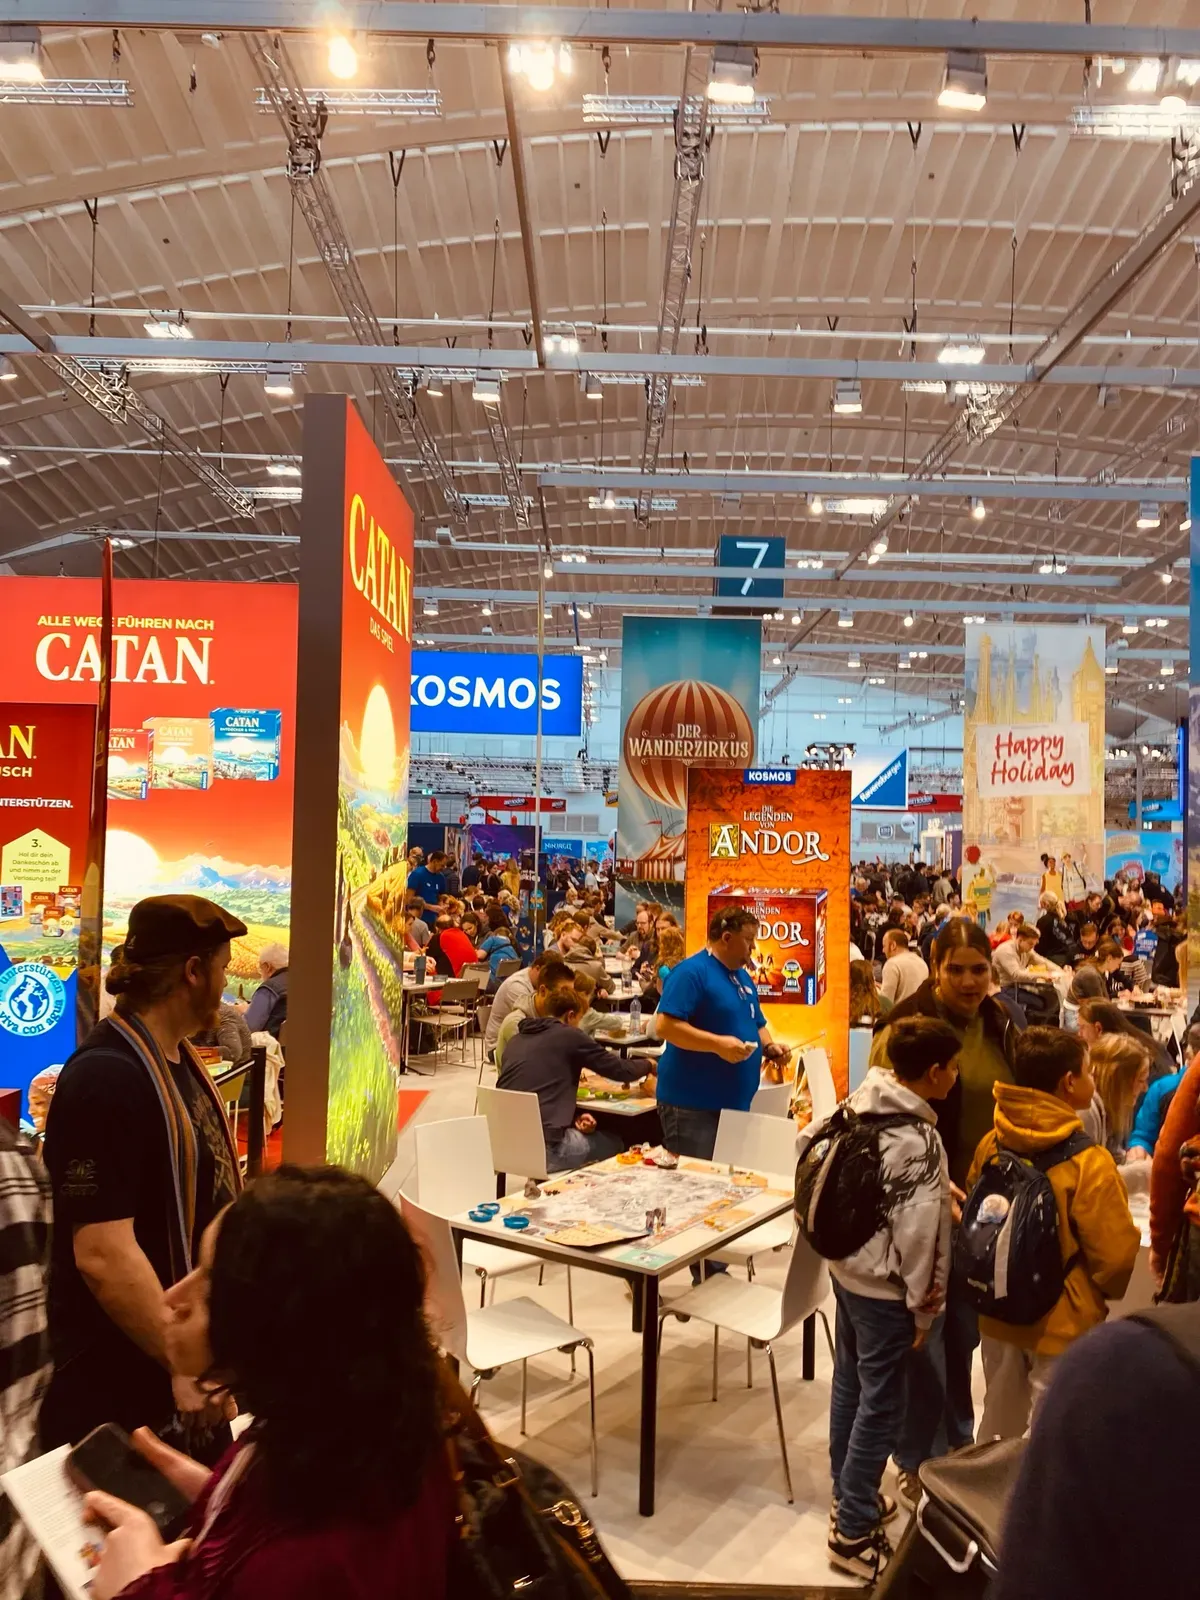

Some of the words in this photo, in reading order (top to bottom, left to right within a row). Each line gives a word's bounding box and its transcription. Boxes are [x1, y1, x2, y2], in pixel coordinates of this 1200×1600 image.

[350, 493, 411, 645] CATAN
[736, 541, 769, 596] 7
[37, 615, 71, 626] ALLE
[73, 616, 114, 627] WEG
[117, 615, 172, 629] FÜHREN
[175, 619, 214, 631] NACH
[370, 616, 381, 641] DAS
[381, 628, 395, 654] SPIEL
[159, 726, 193, 736] CATAN
[225, 716, 259, 728] CATAN
[677, 723, 701, 739] DER
[108, 736, 136, 748] TAN
[628, 737, 749, 758] WANDERZIRKUS
[995, 731, 1064, 761] Happy
[0, 766, 33, 778] SCH
[748, 771, 792, 782] KOSMOS
[859, 760, 902, 803] Ravensburger
[991, 758, 1074, 787] Holiday
[743, 811, 793, 822] LEGENDEN
[31, 838, 42, 848] 3.
[710, 824, 829, 865] ANDOR
[757, 921, 809, 949] DOR
[0, 964, 63, 995] unterstützen
[0, 1011, 19, 1033] viva
[22, 1023, 46, 1034] con
[45, 999, 64, 1026] agua
